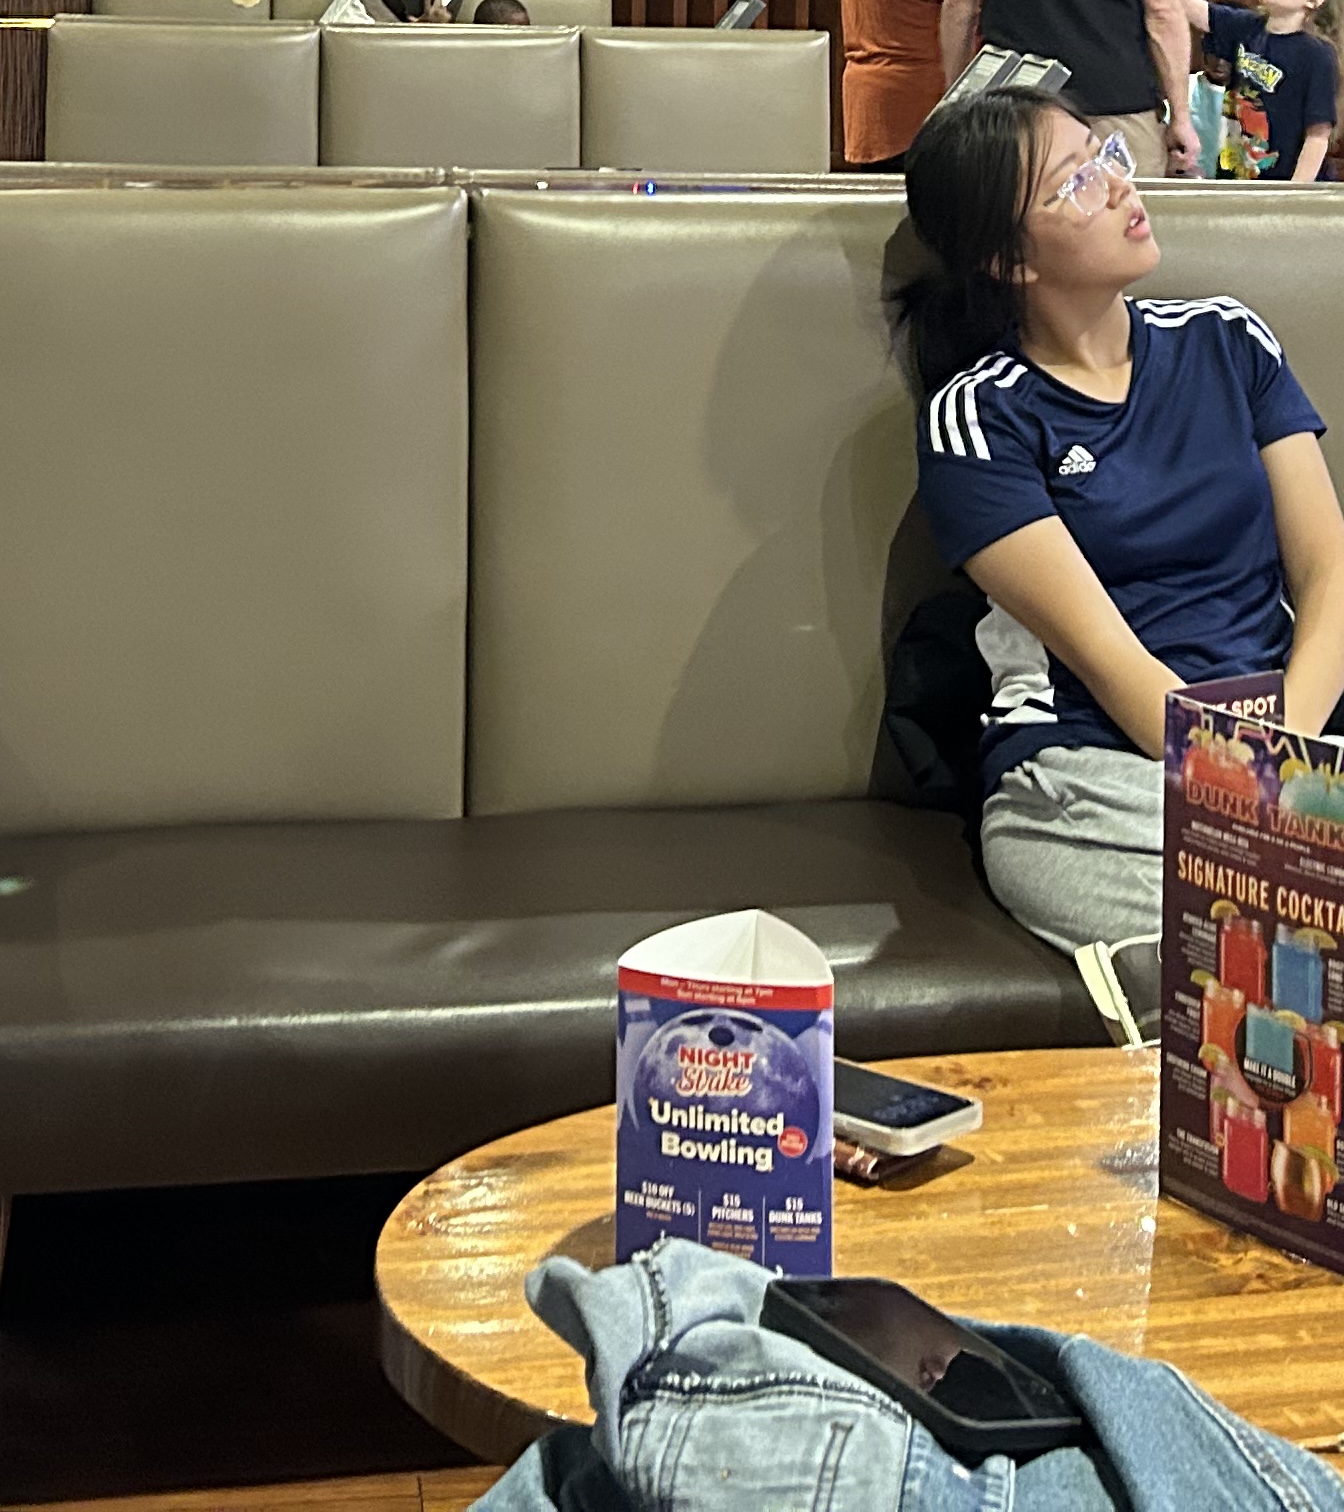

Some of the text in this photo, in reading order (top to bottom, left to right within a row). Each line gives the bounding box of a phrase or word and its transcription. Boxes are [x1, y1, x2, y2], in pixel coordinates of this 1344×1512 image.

[1059, 461, 1096, 475] adida
[1232, 695, 1276, 717] SPOT
[1185, 780, 1259, 827] DUNK
[1177, 850, 1270, 912] SIGNATURE
[678, 1045, 755, 1071] NIGHT
[676, 1066, 752, 1097] Strike
[650, 1099, 784, 1136] Unlimited
[661, 1131, 773, 1171] Bowling
[659, 1185, 675, 1198] OFF
[646, 1196, 681, 1214] BUCKETS
[712, 1206, 754, 1222] PITCHERS
[769, 1210, 822, 1225] DUNK TANKS
